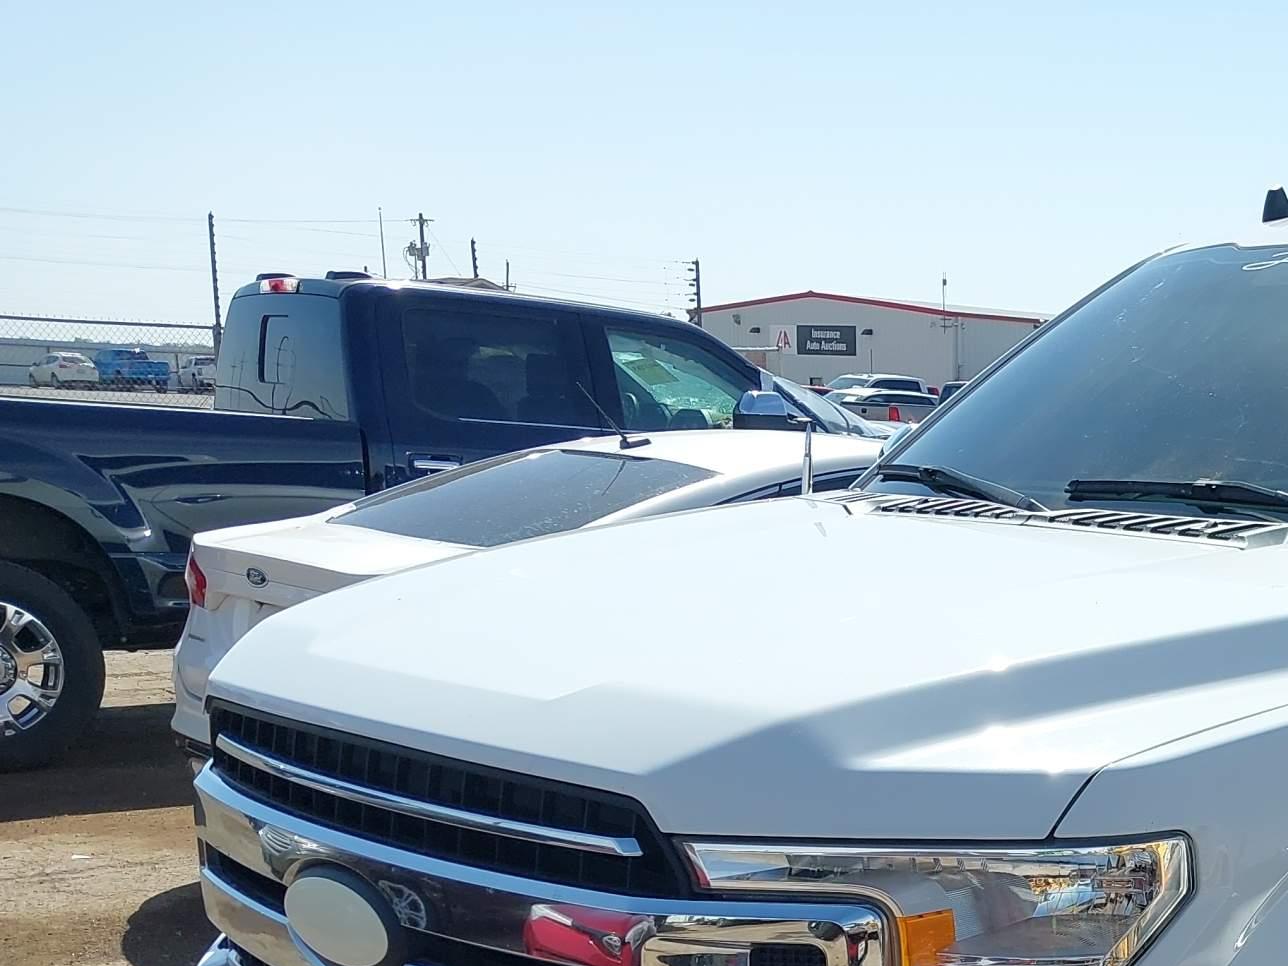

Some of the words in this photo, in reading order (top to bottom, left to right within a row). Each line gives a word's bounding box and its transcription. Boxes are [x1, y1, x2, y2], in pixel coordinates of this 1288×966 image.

[811, 328, 841, 339] Insurance
[806, 340, 820, 350] Auto
[820, 340, 847, 351] Auctions
